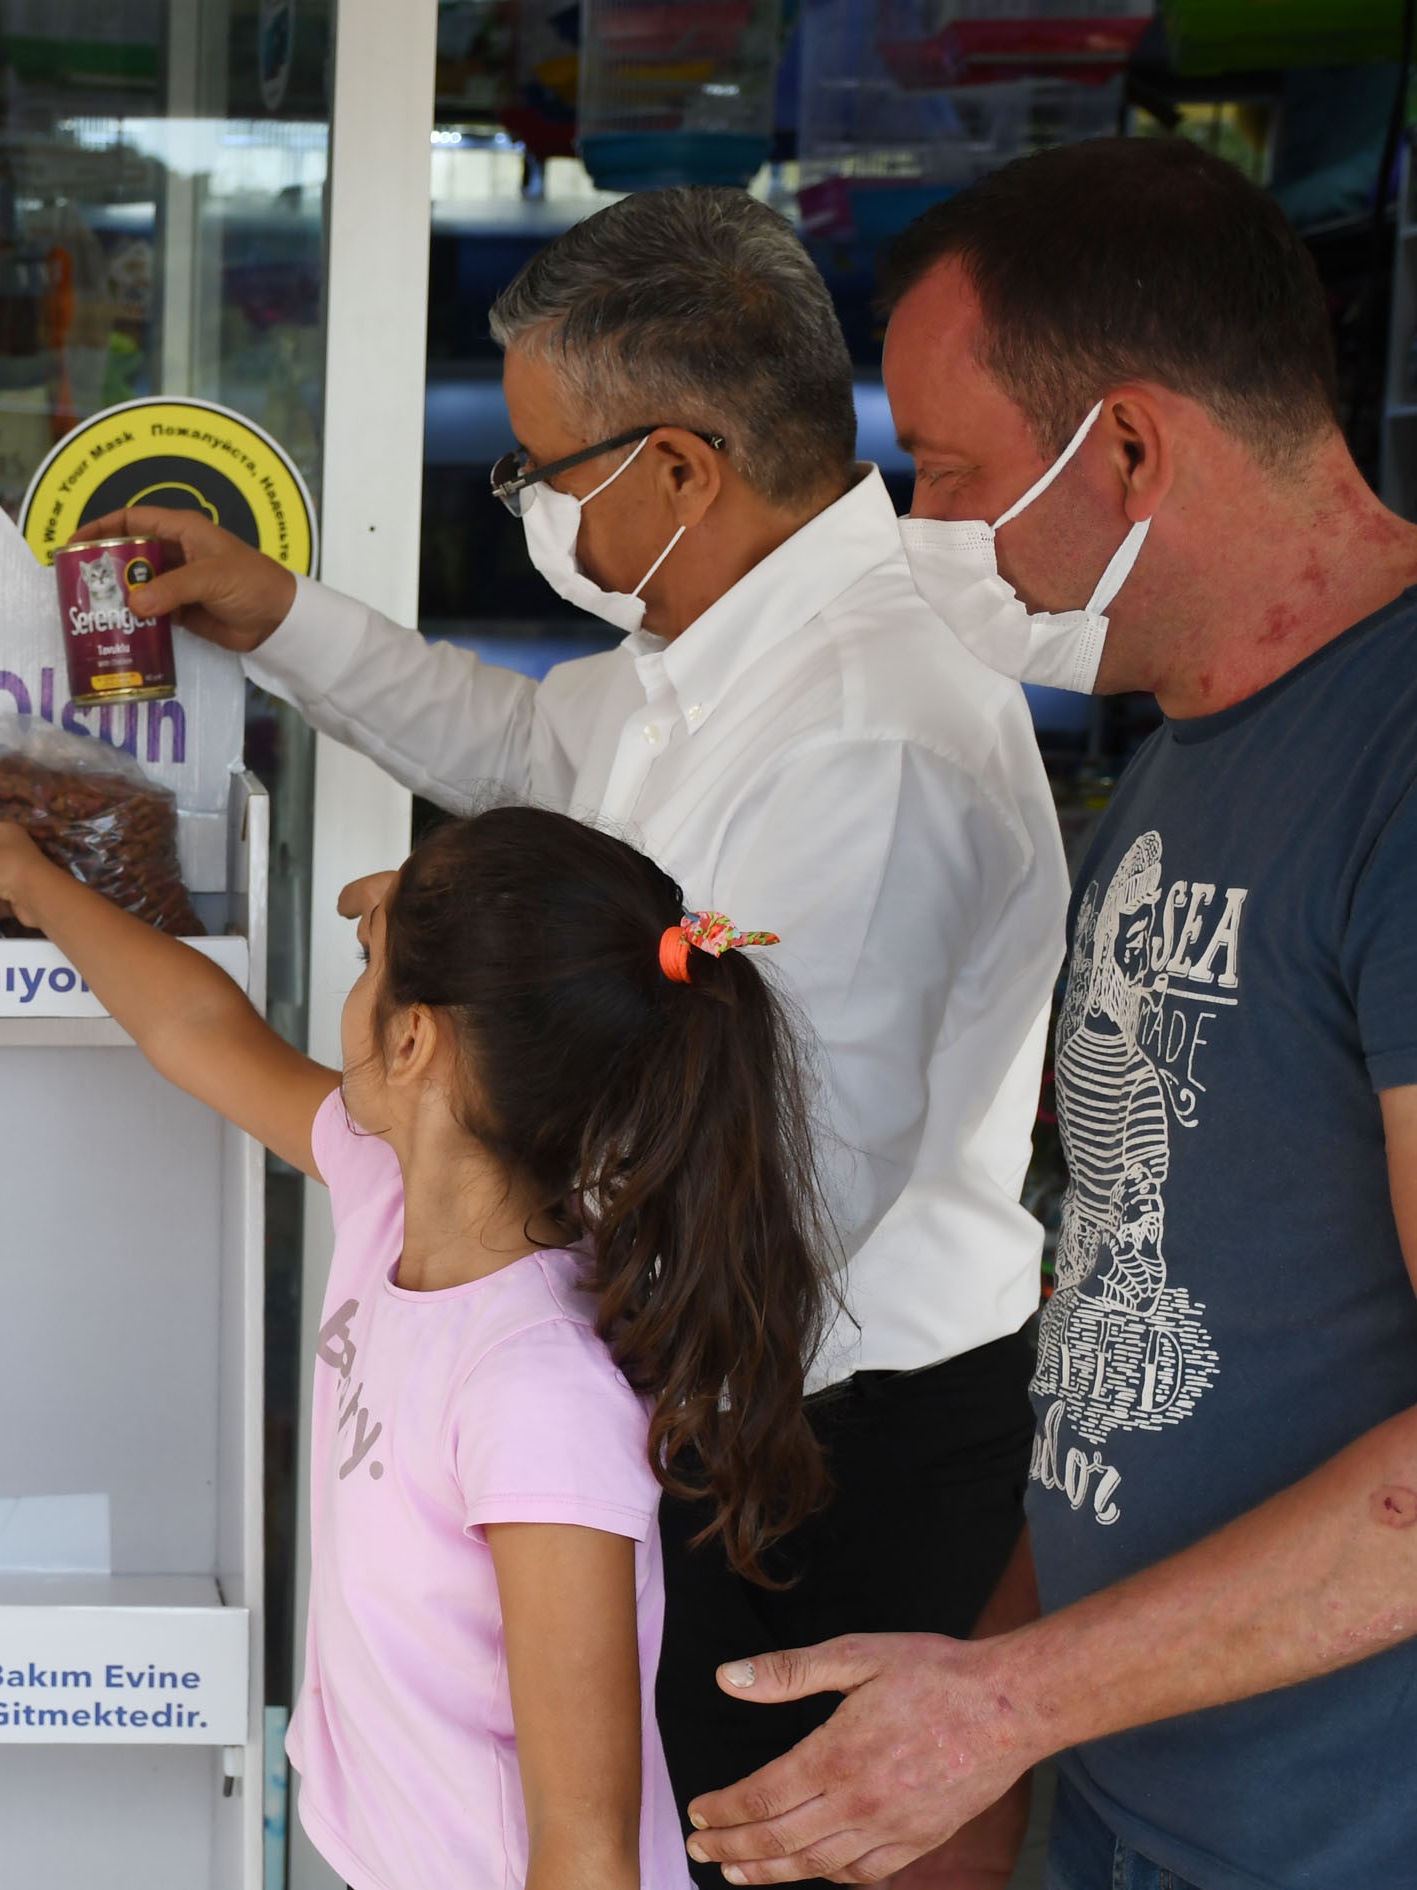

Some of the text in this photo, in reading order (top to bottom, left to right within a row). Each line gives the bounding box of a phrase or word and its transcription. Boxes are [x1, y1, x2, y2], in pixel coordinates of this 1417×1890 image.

[59, 461, 90, 494] Your
[90, 431, 135, 460] Mask
[1150, 880, 1248, 988] SEA
[105, 1664, 201, 1689] Evine
